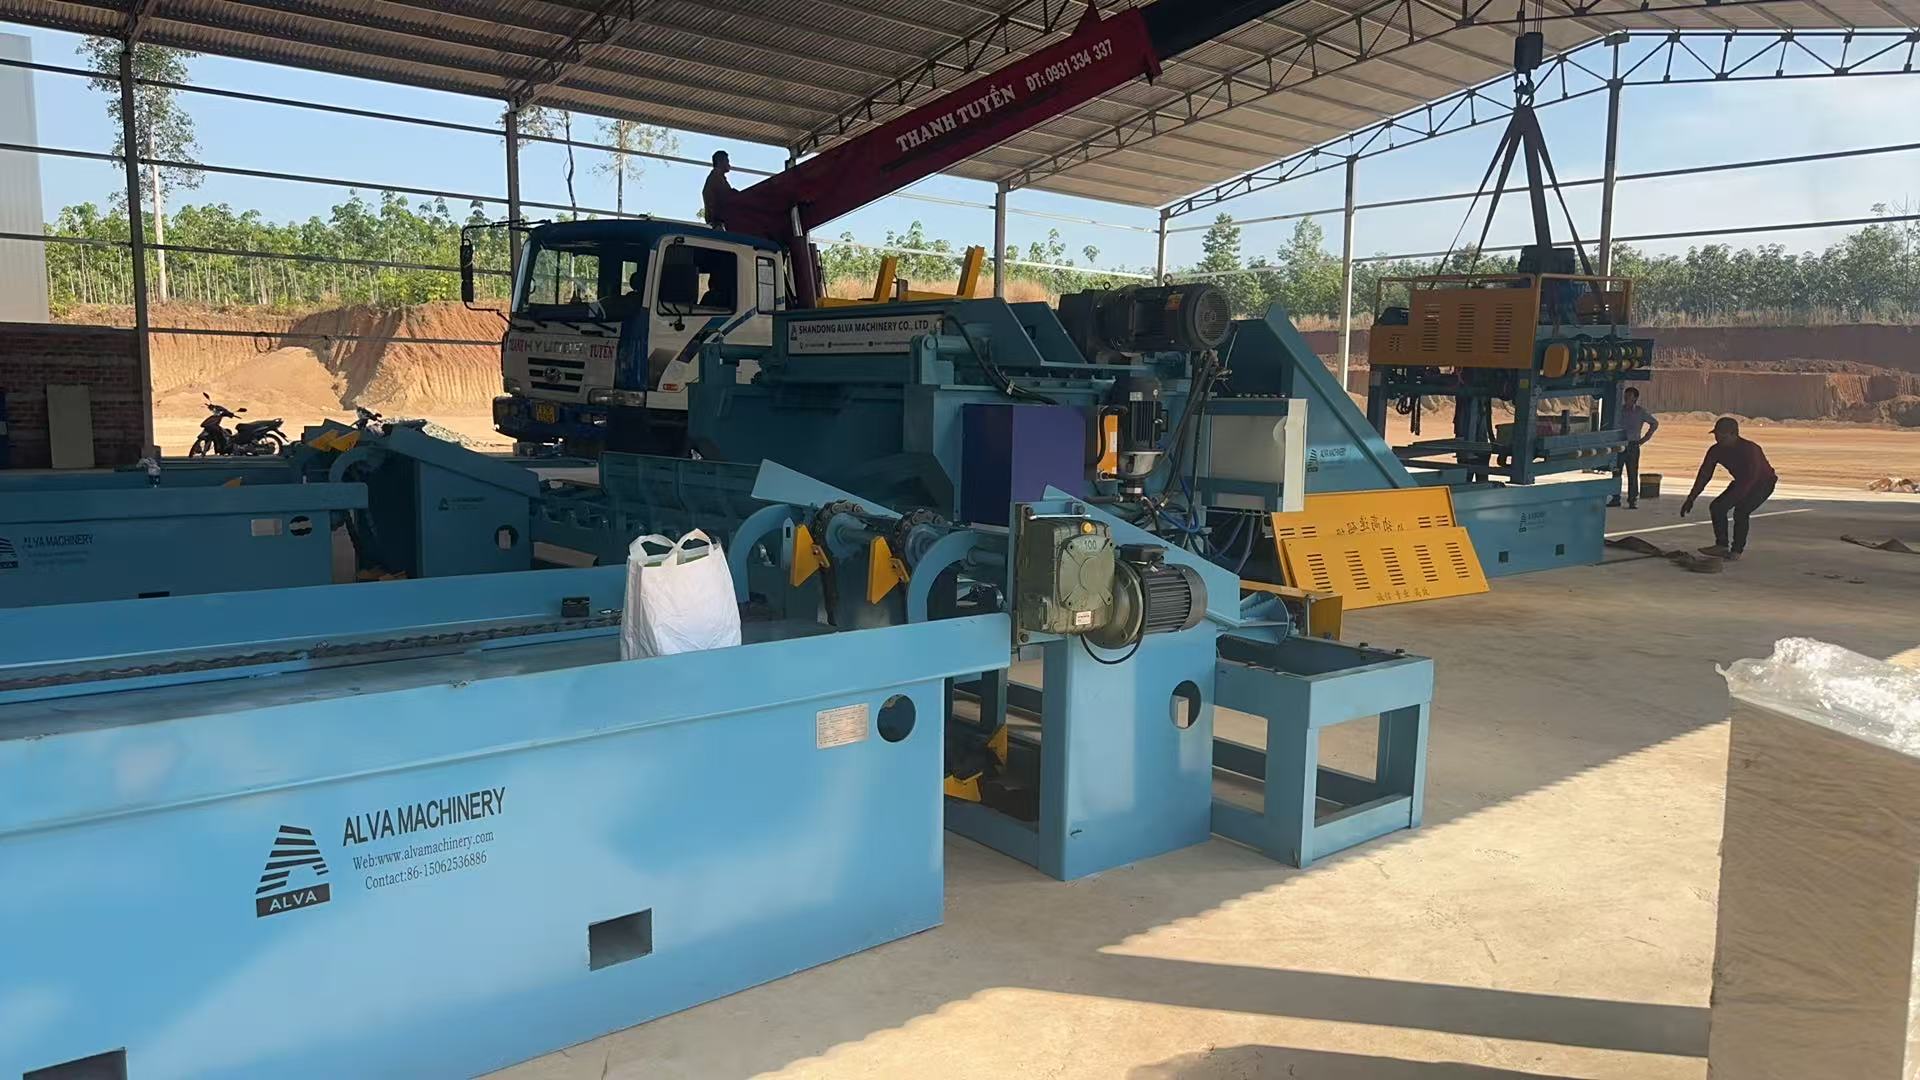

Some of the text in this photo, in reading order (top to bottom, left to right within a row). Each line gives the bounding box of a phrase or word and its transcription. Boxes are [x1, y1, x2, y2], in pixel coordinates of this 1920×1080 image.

[896, 113, 957, 152] THANH
[1045, 59, 1072, 83] 0931
[1070, 49, 1092, 71] 334
[1093, 39, 1113, 60] 337
[799, 324, 836, 335] SHANDONG
[837, 324, 853, 333] ALVA
[855, 321, 897, 332] MACHINERY
[1084, 539, 1097, 550] 100
[343, 787, 506, 847] ALVA MACHINERY
[352, 830, 495, 871] Web:www.alvamachinery.com
[365, 850, 488, 890] Contact:86-15062536886
[269, 889, 318, 912] ALVA
